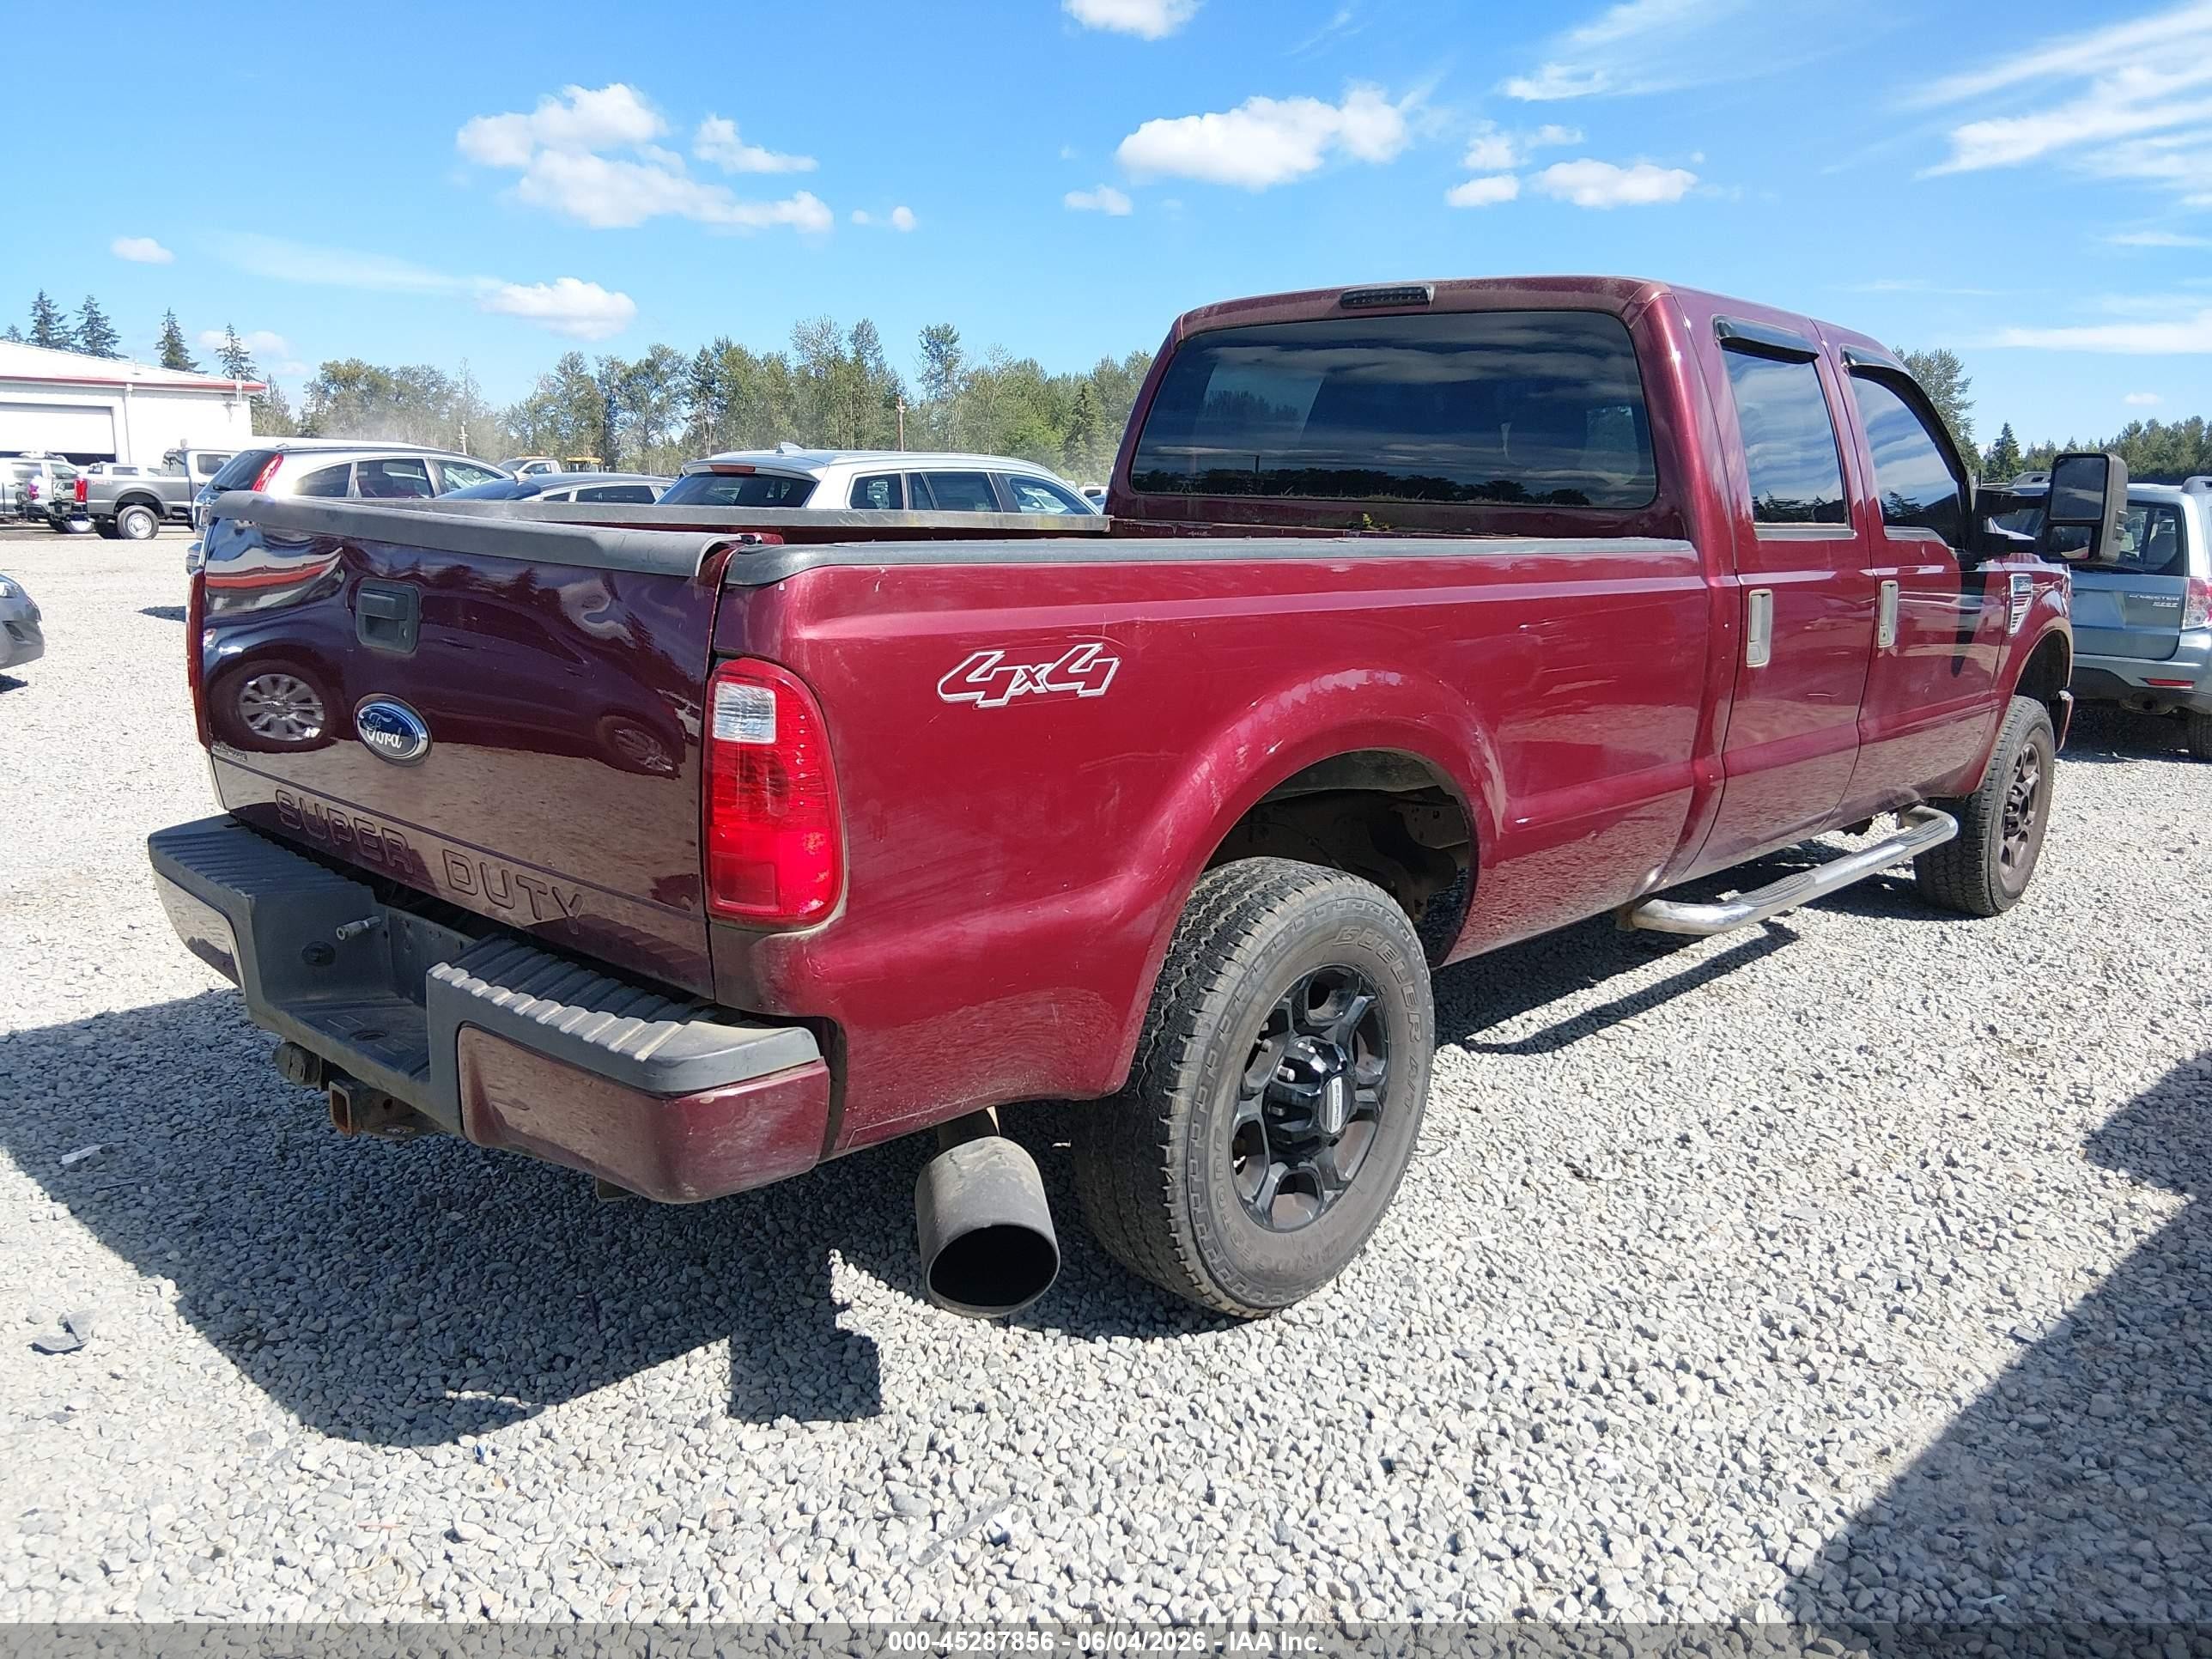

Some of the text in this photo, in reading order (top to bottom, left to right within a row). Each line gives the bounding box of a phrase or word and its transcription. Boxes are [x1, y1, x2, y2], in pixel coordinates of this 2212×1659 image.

[937, 642, 1121, 708] 4x4
[363, 712, 403, 749] Ford
[275, 788, 585, 936] SUPER DUTY
